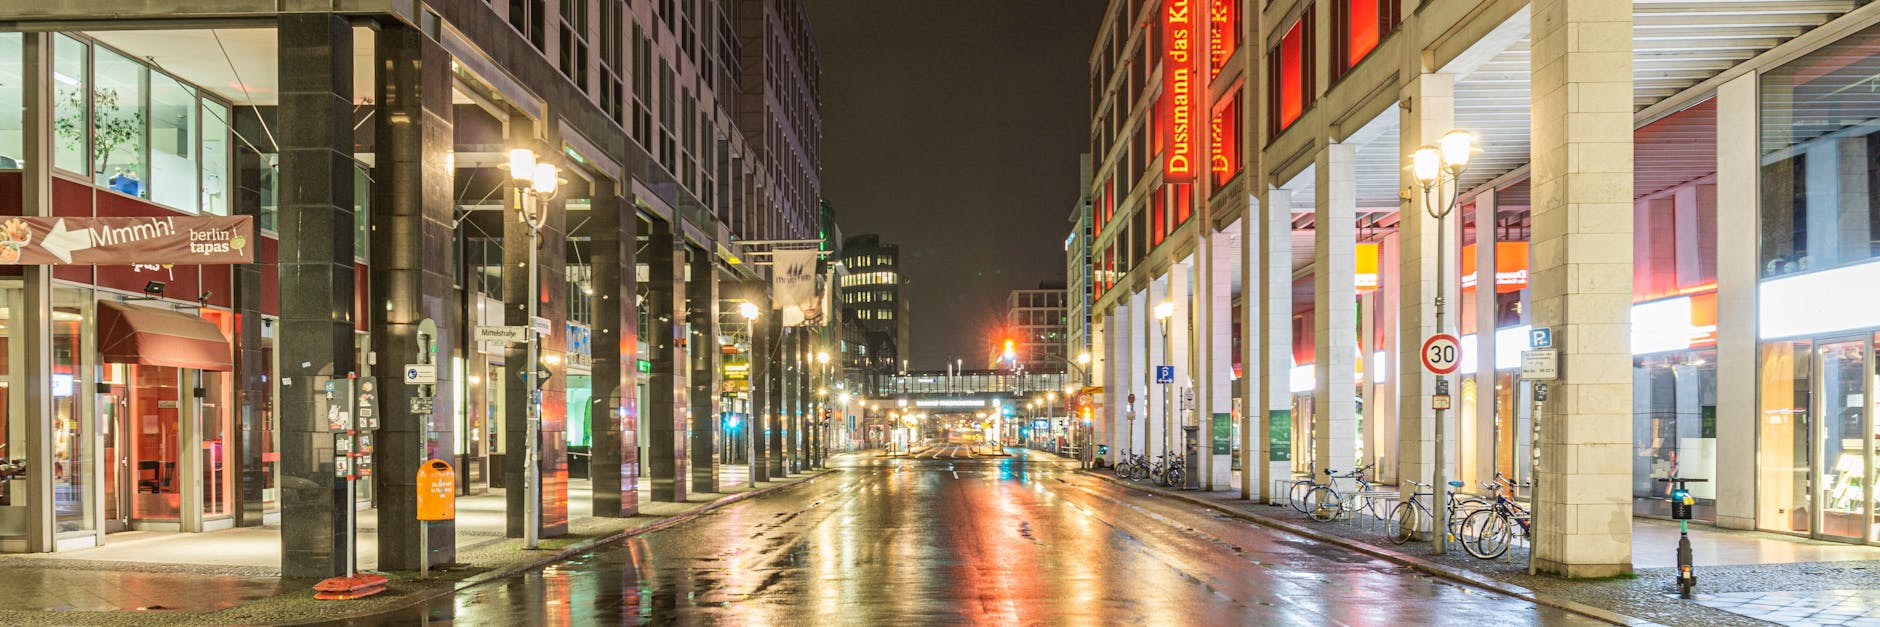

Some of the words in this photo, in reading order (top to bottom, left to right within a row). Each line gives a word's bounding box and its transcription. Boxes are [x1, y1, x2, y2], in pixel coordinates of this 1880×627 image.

[1169, 29, 1188, 62] das
[1169, 68, 1189, 173] Dussmann
[90, 215, 175, 247] Mmmh!
[189, 228, 230, 241] berlin
[189, 242, 229, 255] tapas
[1431, 345, 1454, 363] 30
